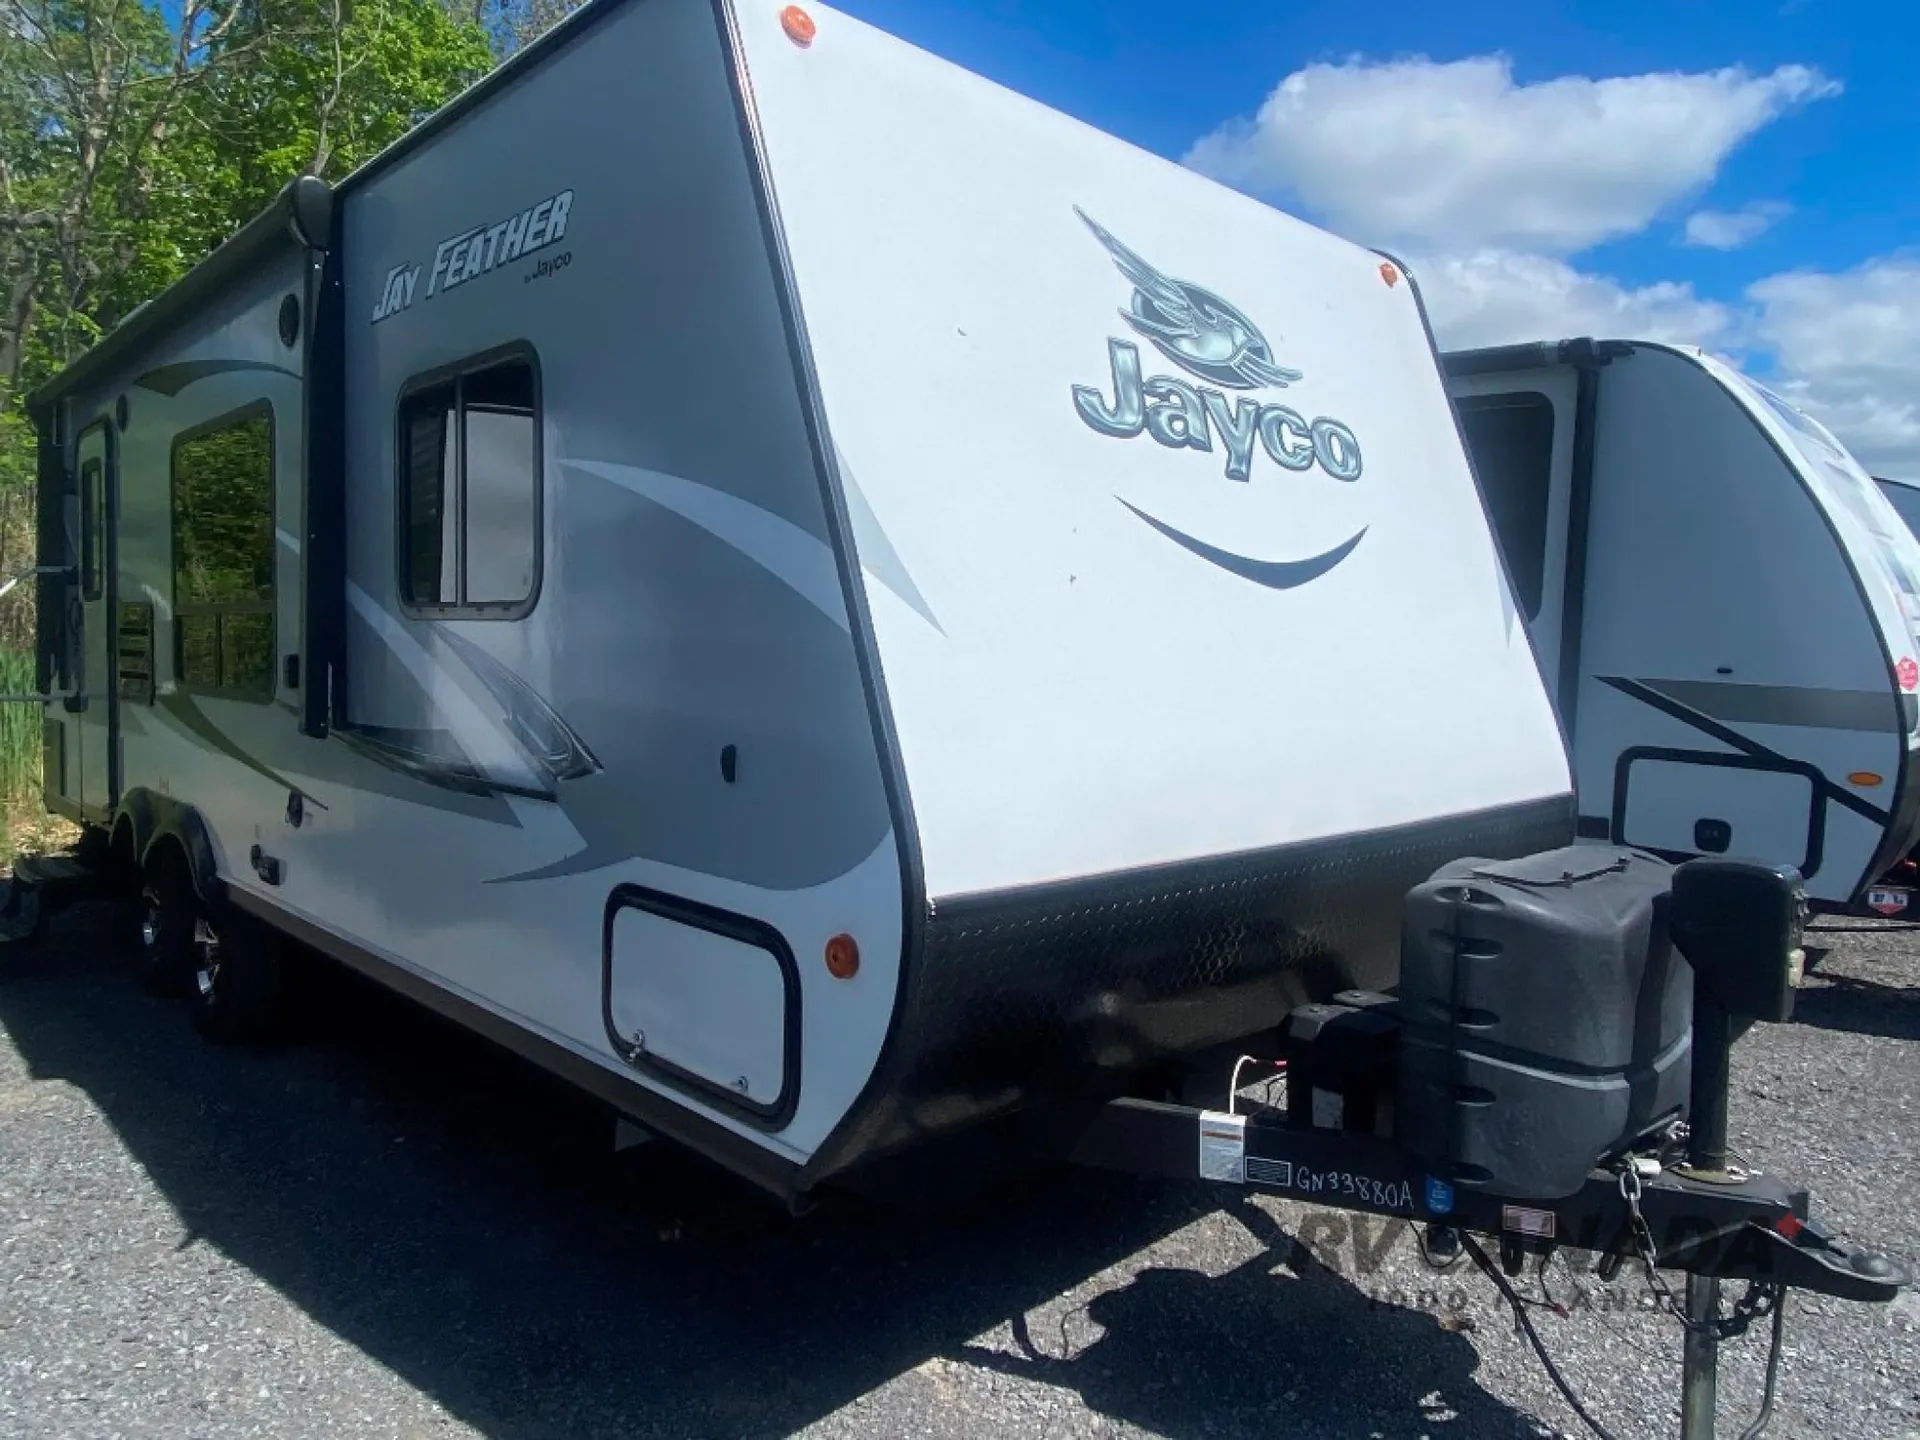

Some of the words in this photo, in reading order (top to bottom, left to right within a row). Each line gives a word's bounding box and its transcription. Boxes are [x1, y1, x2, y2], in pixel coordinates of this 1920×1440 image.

[371, 261, 423, 325] JAY
[425, 188, 574, 301] FEATHER
[532, 250, 573, 279] Jayco
[1071, 336, 1363, 483] Jayco
[1296, 1166, 1415, 1211] GN33880A
